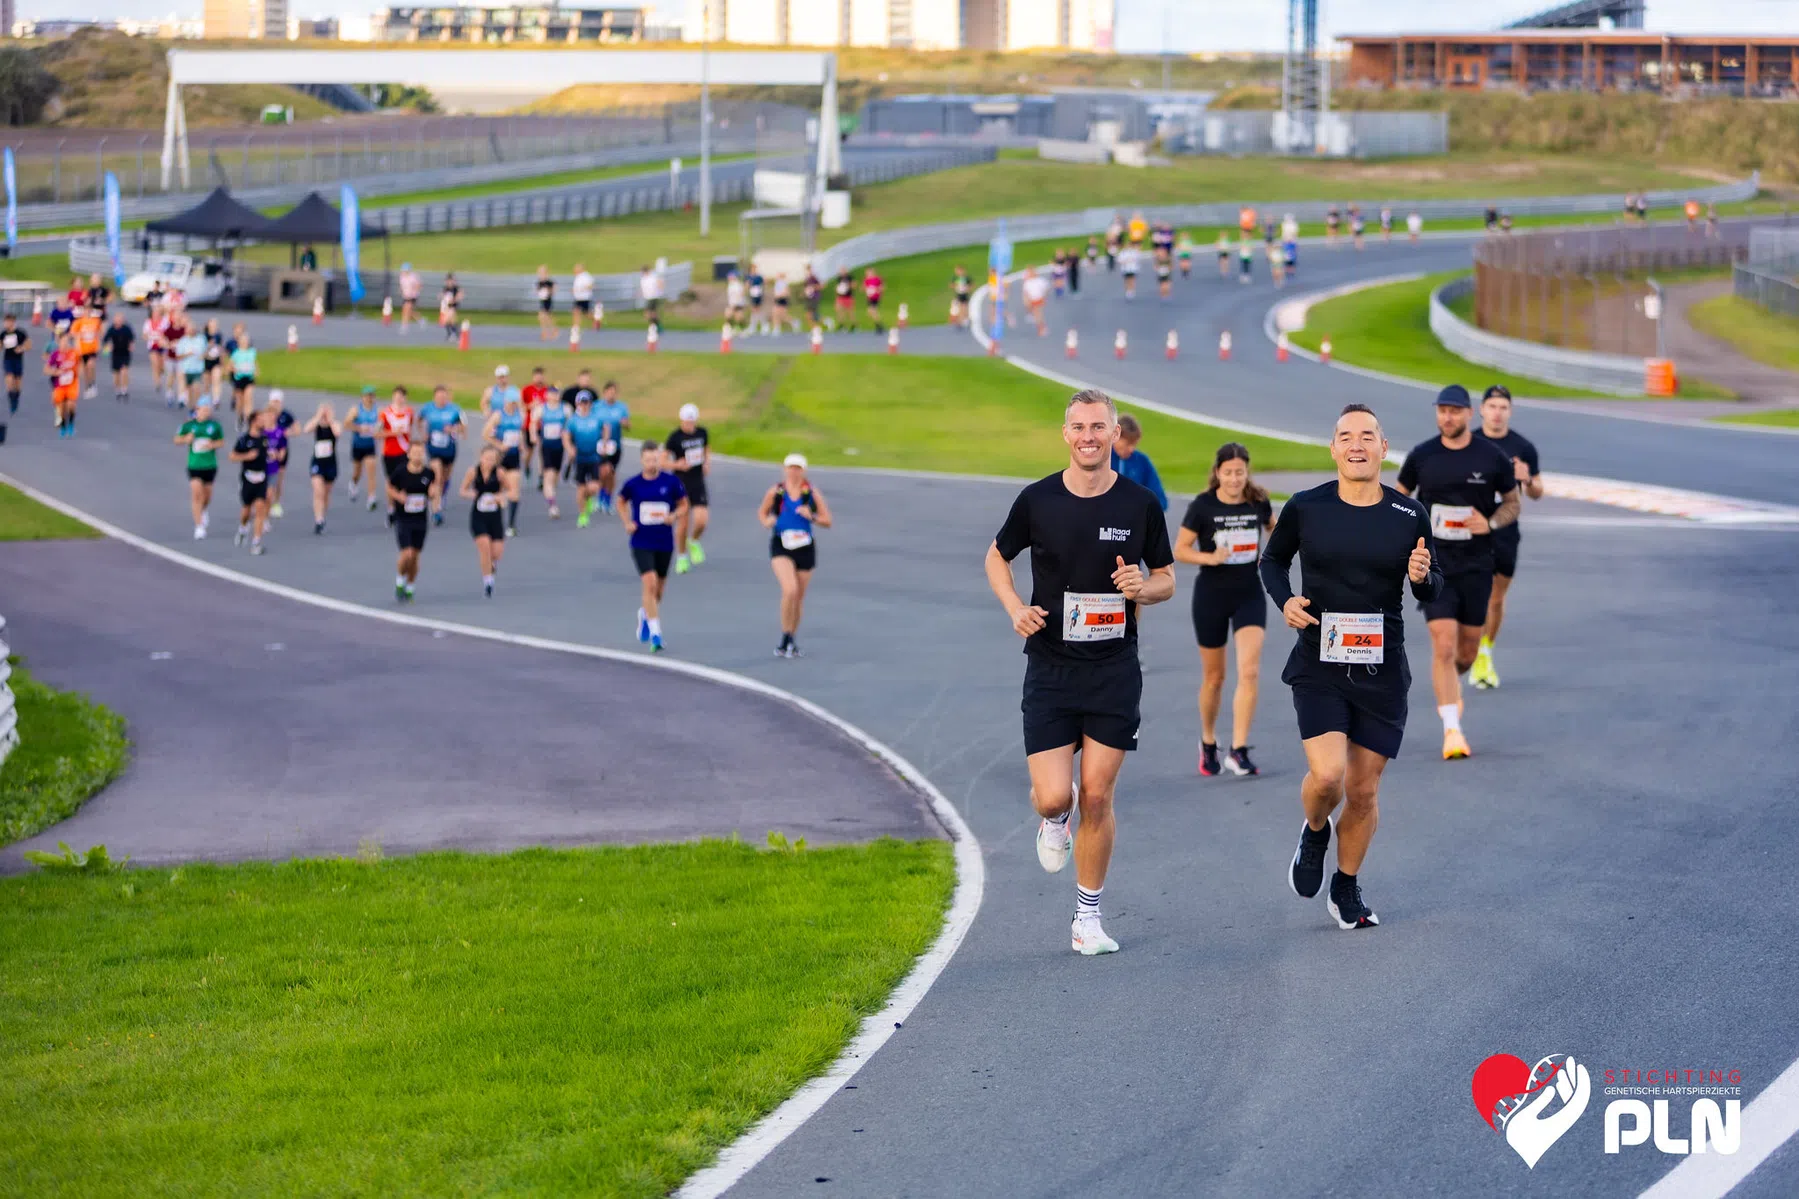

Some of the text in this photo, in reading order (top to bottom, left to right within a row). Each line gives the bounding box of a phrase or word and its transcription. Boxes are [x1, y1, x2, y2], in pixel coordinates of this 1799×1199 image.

[1391, 502, 1413, 514] CRAFT
[1097, 613, 1114, 624] 50
[1354, 635, 1372, 646] 24
